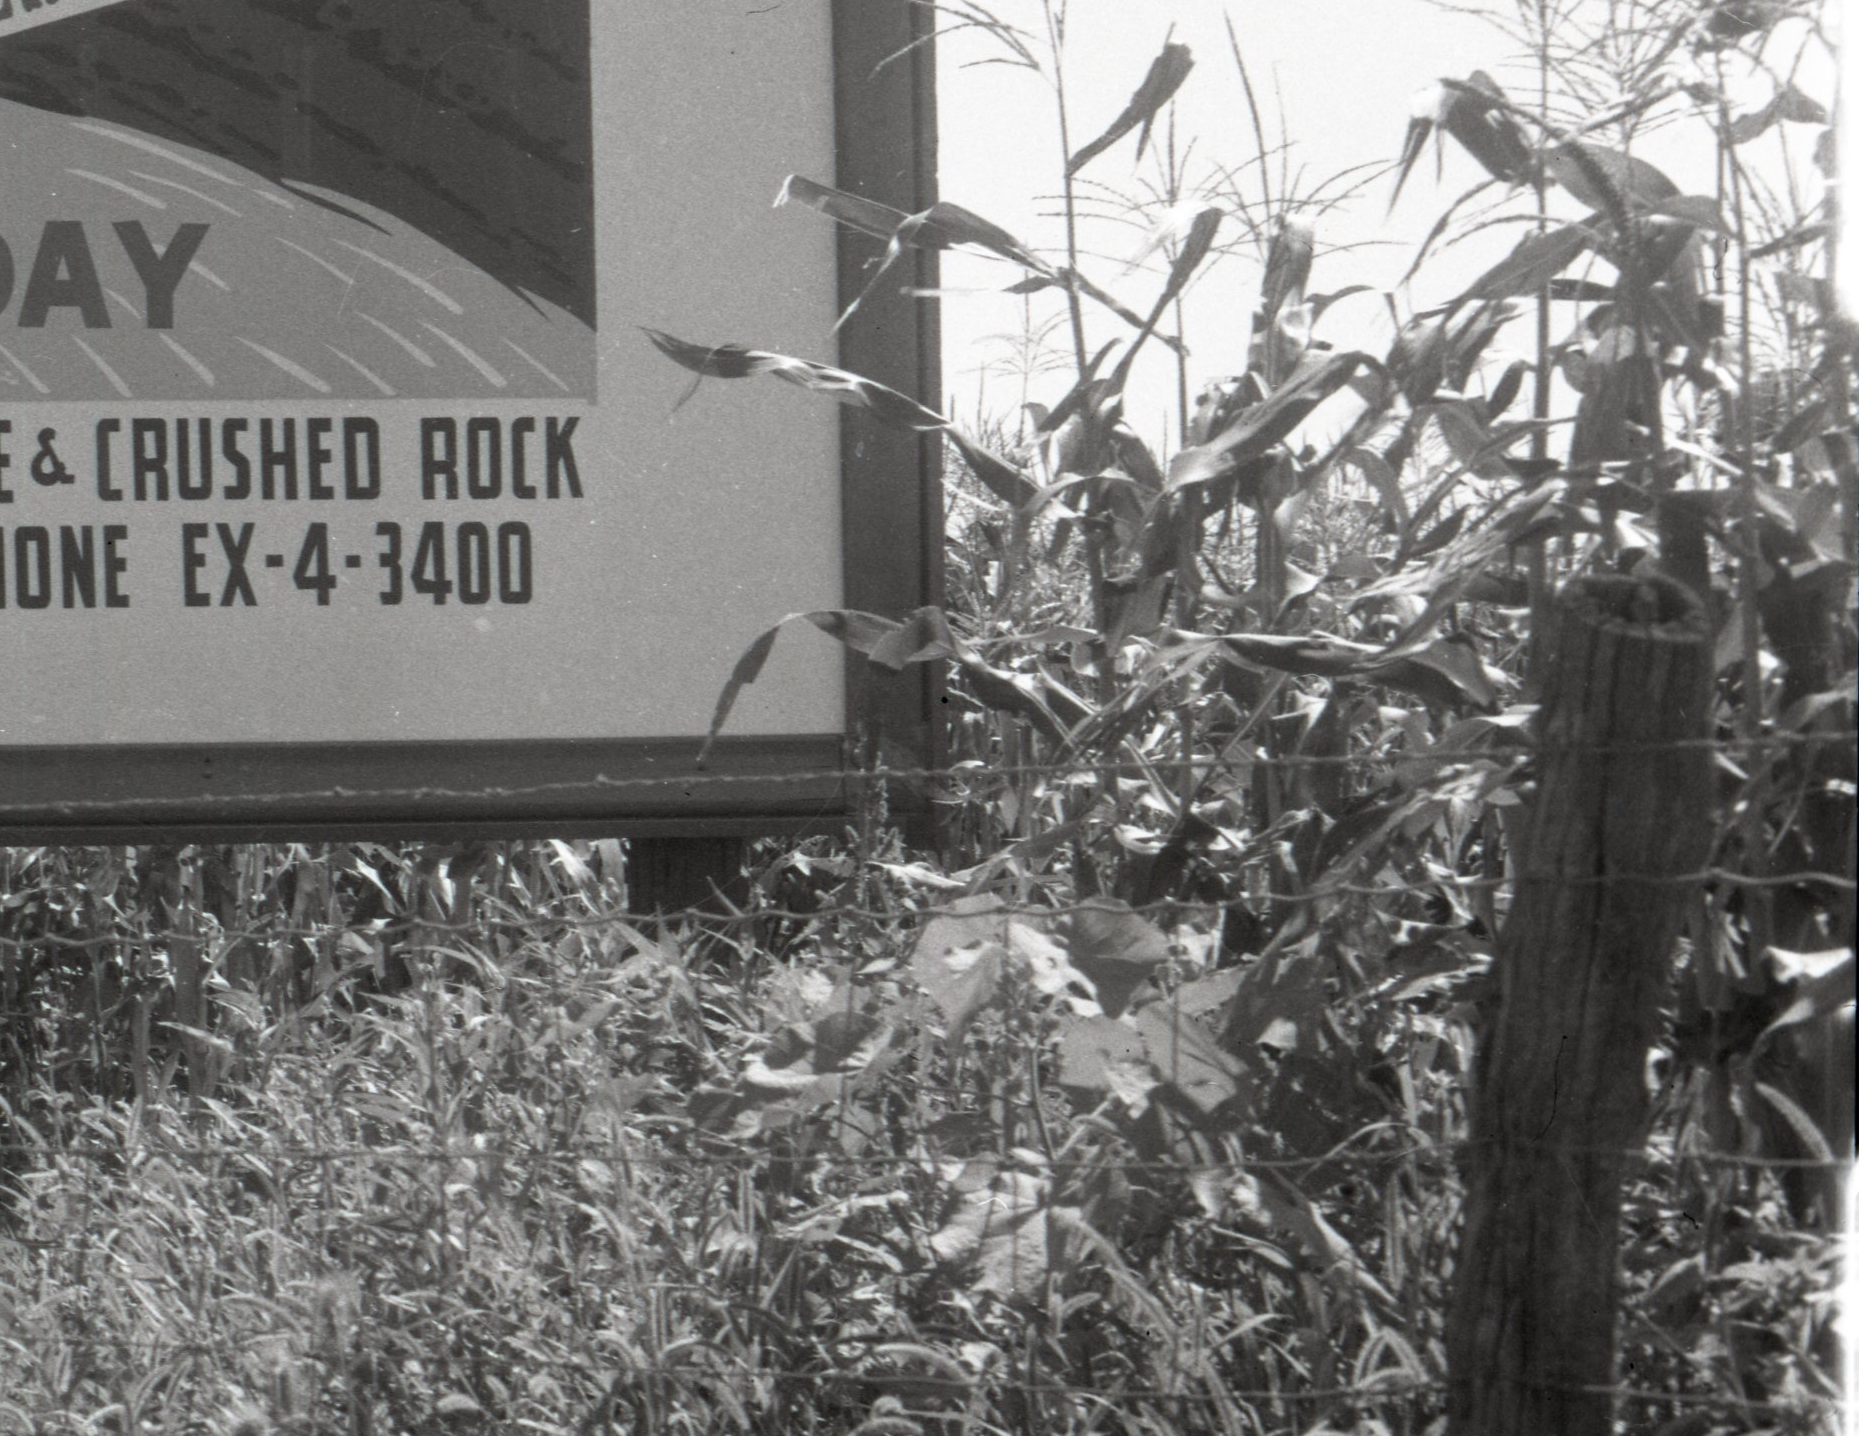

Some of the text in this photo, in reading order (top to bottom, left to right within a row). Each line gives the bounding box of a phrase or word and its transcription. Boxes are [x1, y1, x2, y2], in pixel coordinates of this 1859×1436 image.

[29, 427, 76, 487] &
[95, 416, 382, 502] CRUSHED
[420, 416, 585, 501] ROCK
[181, 520, 534, 608] EX-4-3400
